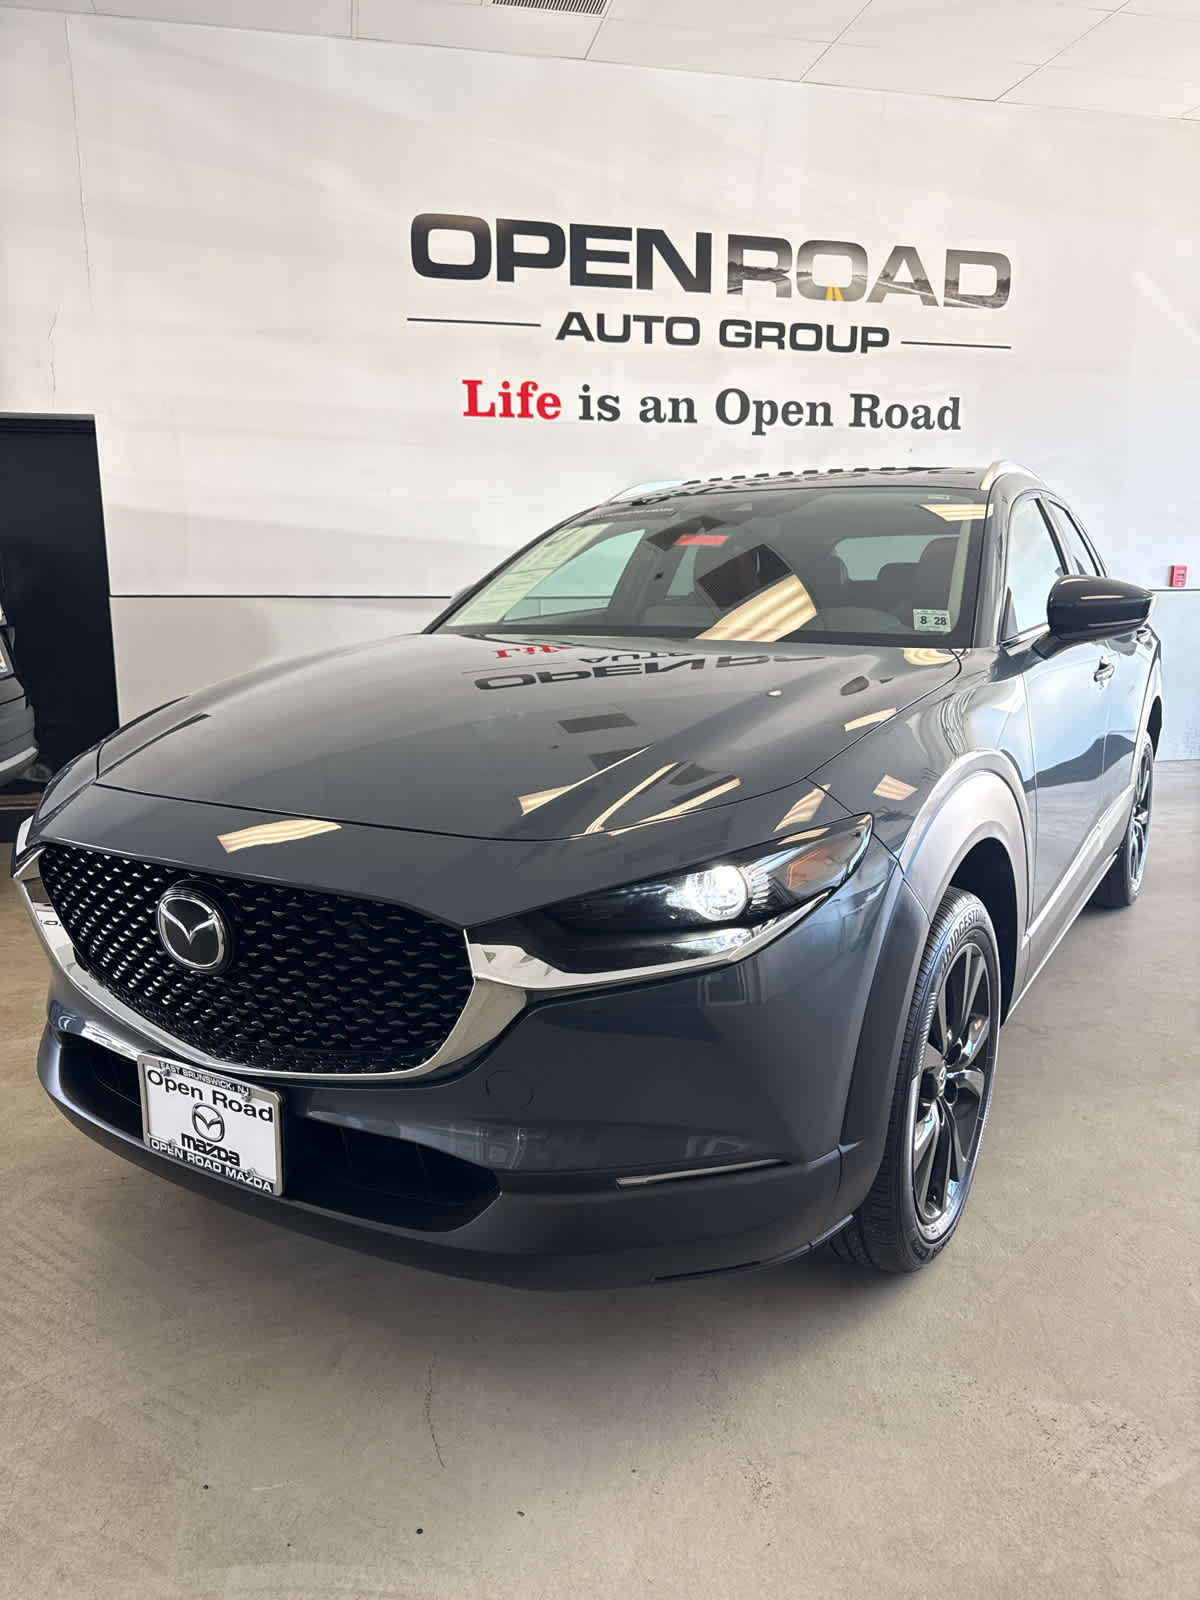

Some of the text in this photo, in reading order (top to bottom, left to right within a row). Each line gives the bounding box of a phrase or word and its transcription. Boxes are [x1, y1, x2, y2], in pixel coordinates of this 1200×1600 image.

[410, 213, 1012, 310] OPEN ROAD
[555, 311, 890, 354] AUTO GROUP
[462, 379, 962, 436] Life is an Open Road
[920, 615, 947, 625] 8 28
[147, 1069, 274, 1123] Open Road
[160, 1062, 183, 1075] EAST
[237, 1084, 250, 1096] NJ
[151, 1139, 273, 1193] OPEN ROAD MAZDA
[181, 1132, 241, 1167] mazda
